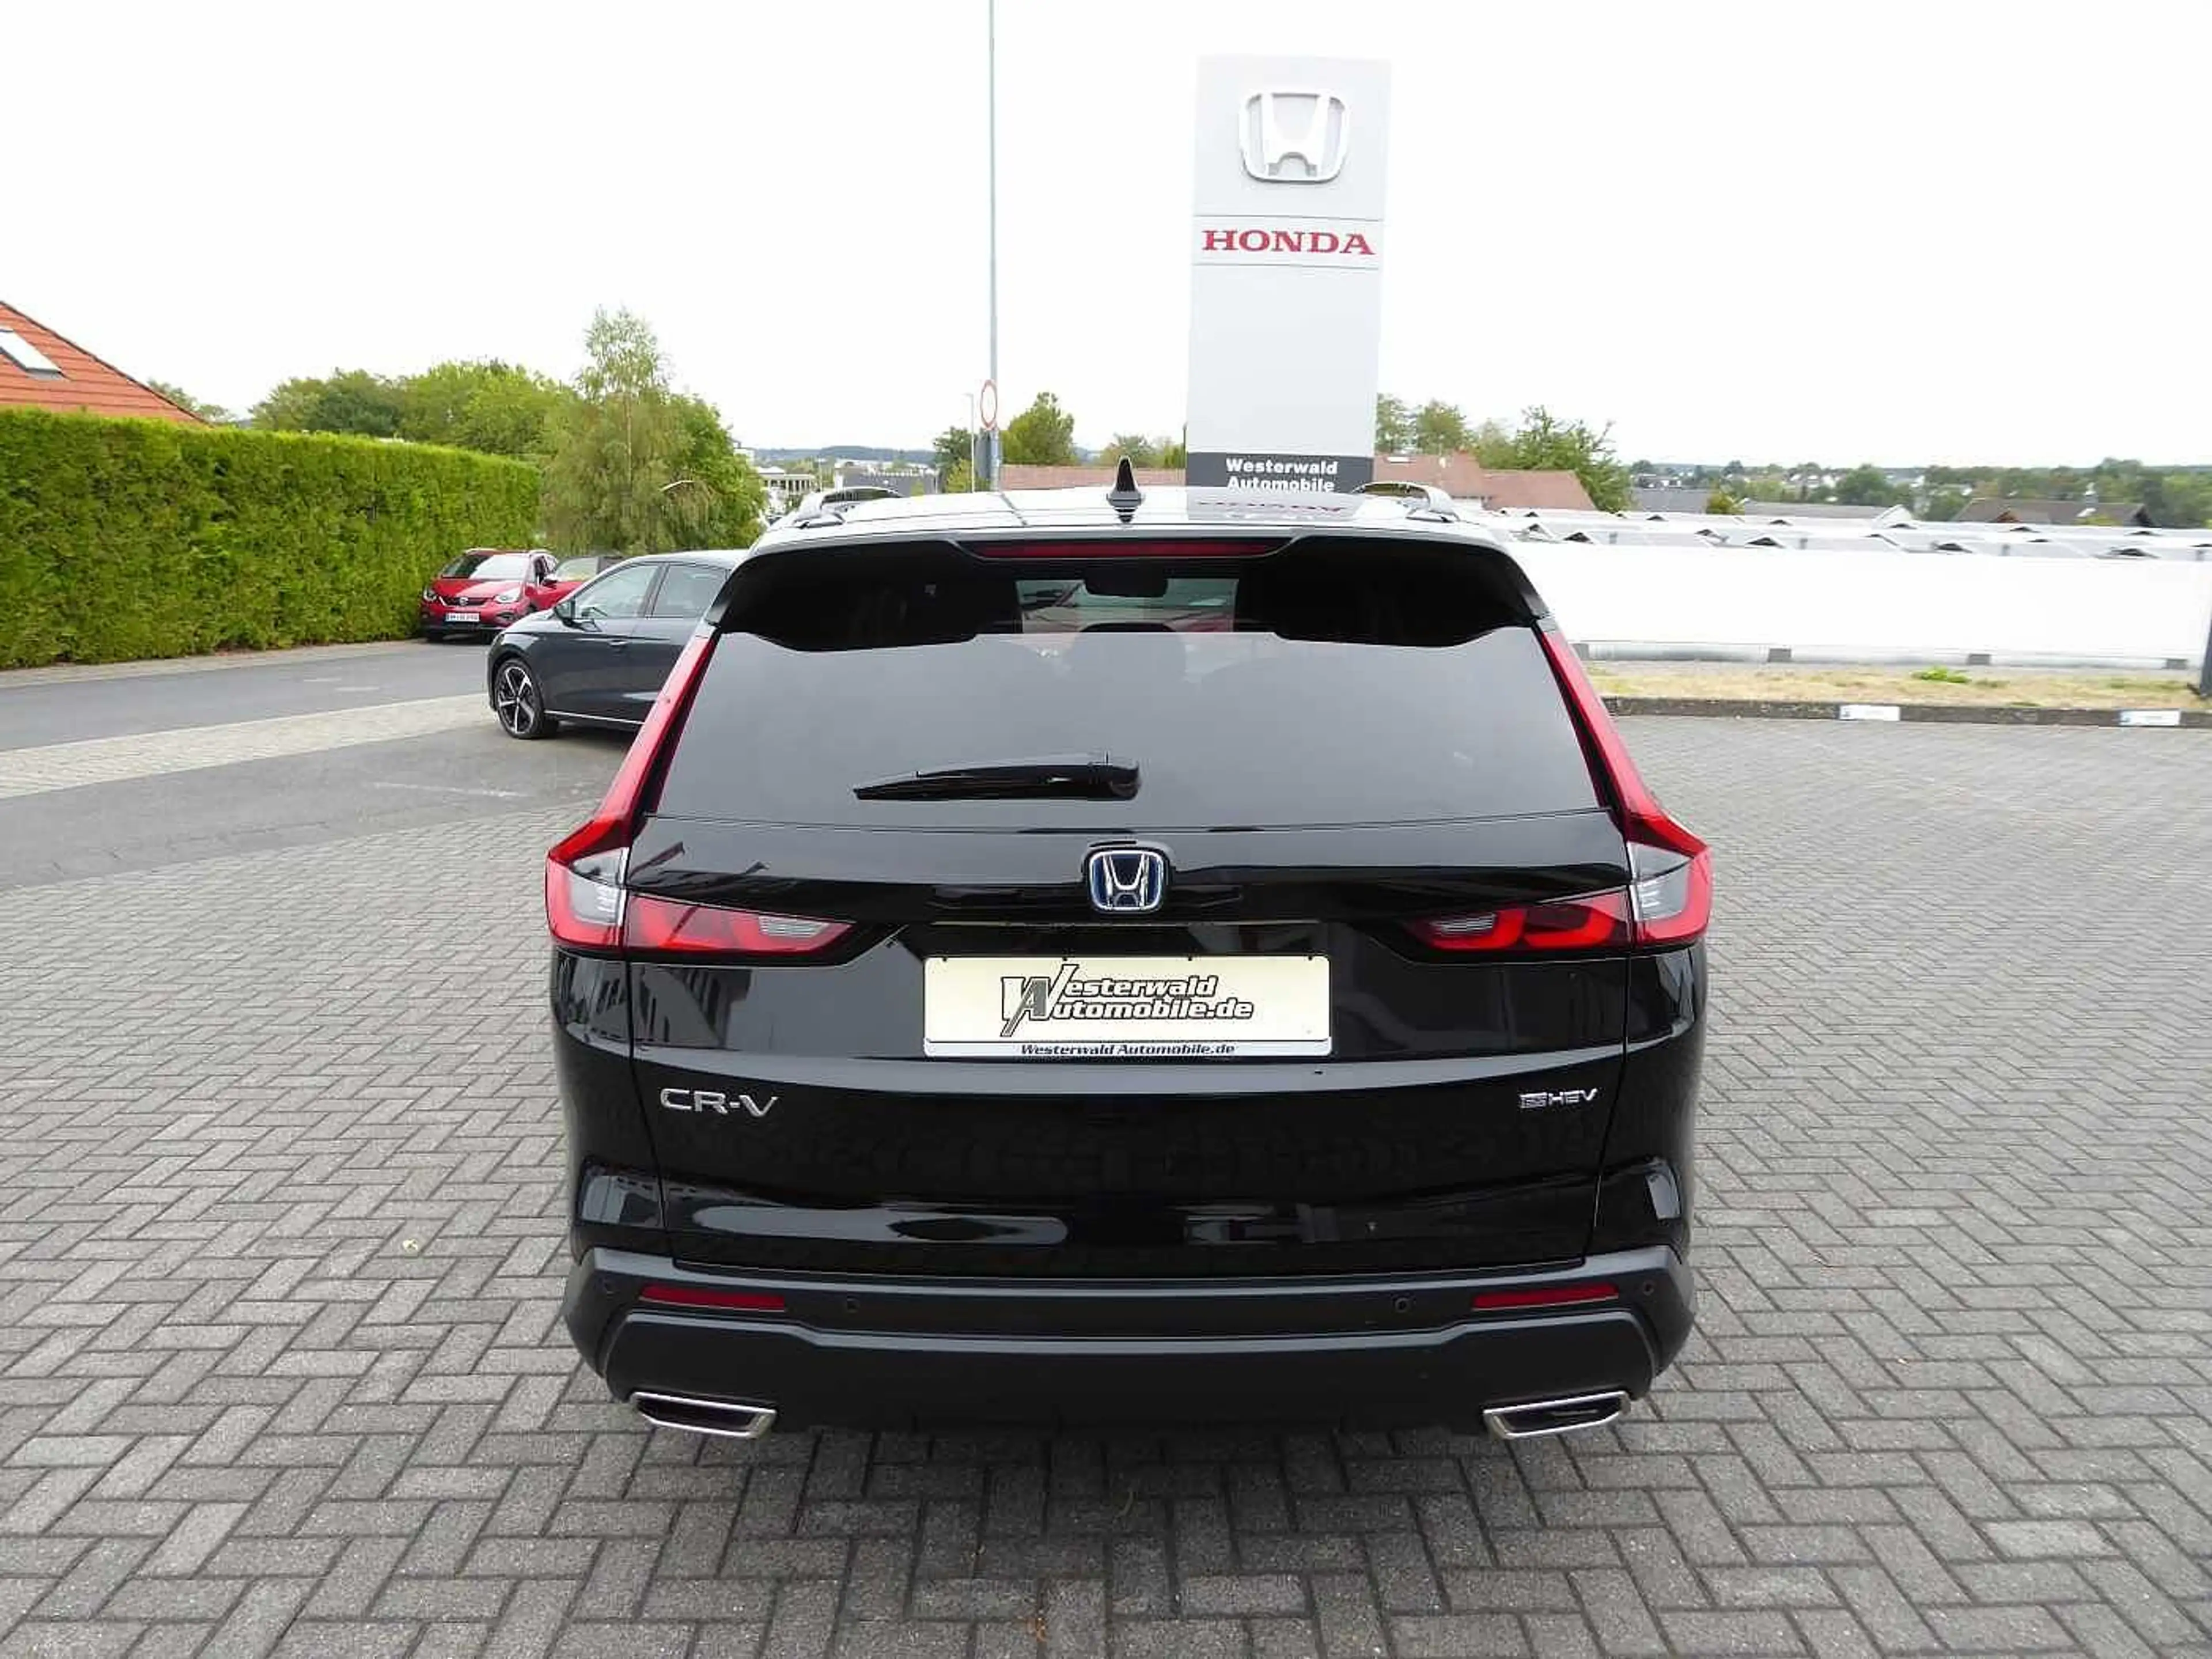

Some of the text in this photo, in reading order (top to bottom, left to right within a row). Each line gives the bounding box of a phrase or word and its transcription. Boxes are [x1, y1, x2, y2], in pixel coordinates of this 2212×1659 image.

[1202, 229, 1376, 255] HONDA
[1226, 458, 1338, 475] Westerwald
[1228, 475, 1335, 492] Automobile
[1001, 964, 1219, 1021] Westerwald
[1021, 1044, 1236, 1055] Westerwald Automobile.de
[661, 1088, 778, 1116] CR-V
